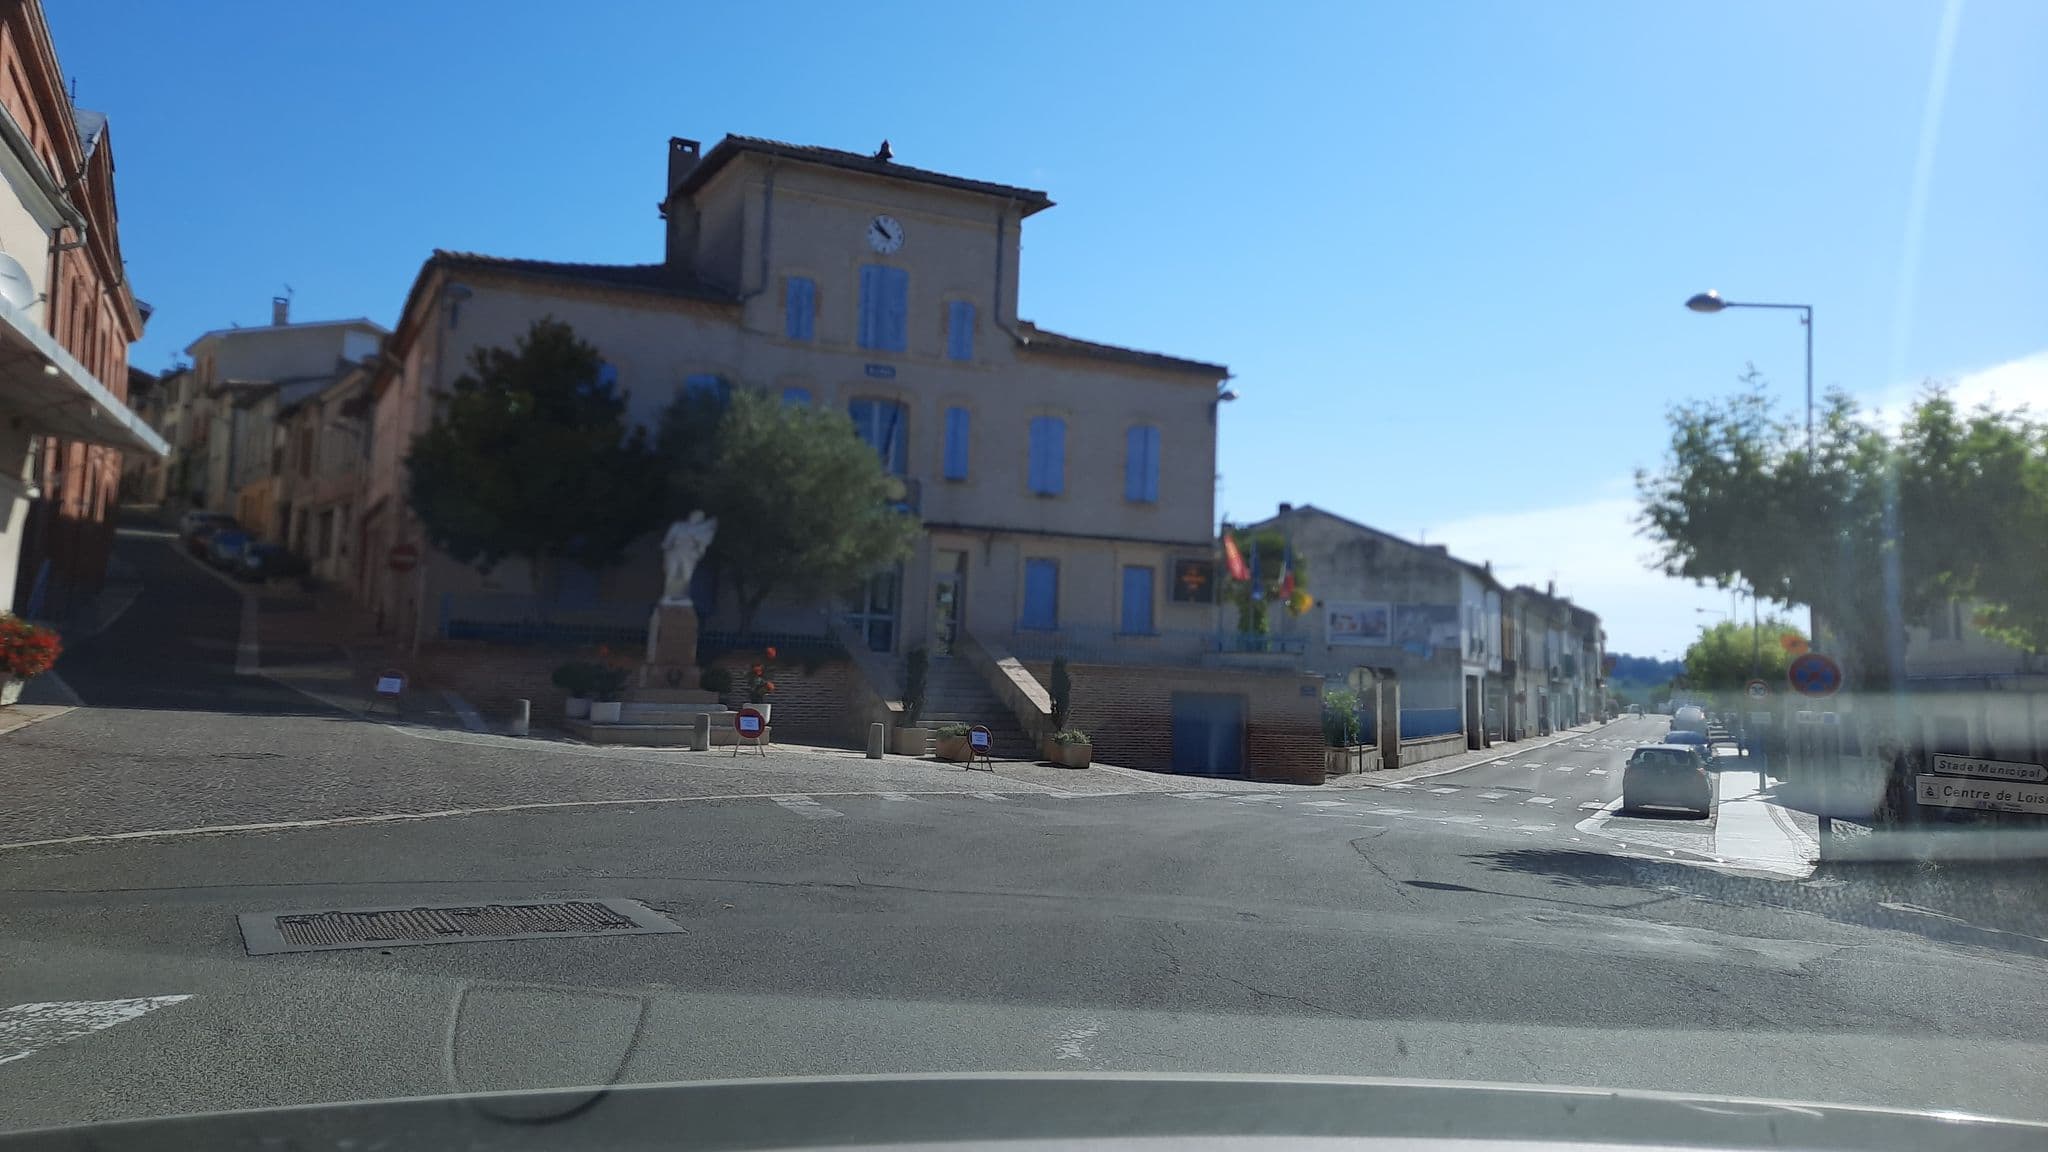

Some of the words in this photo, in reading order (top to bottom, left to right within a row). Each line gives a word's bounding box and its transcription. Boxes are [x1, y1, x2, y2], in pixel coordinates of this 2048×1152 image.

[1938, 760, 1974, 772] Stade
[1977, 763, 2041, 778] Municipal
[1943, 785, 1991, 800] Centre
[1996, 790, 2012, 801] de
